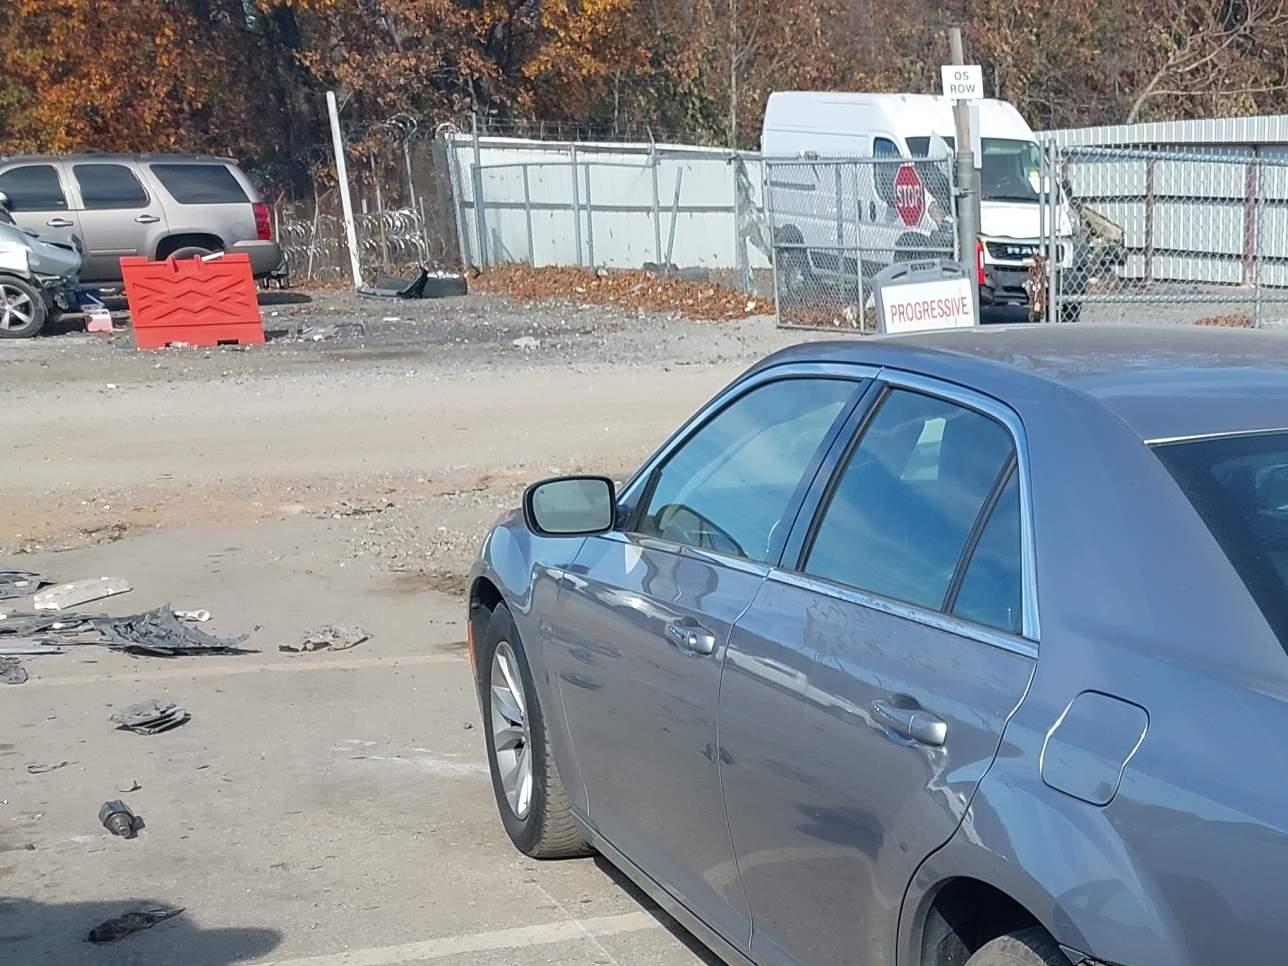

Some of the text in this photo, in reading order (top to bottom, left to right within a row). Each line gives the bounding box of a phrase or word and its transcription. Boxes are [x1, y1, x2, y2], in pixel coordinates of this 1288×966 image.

[954, 71, 969, 81] OS
[950, 84, 976, 94] ROW
[896, 184, 920, 208] STOP
[890, 296, 969, 324] PROGRESSIVE
